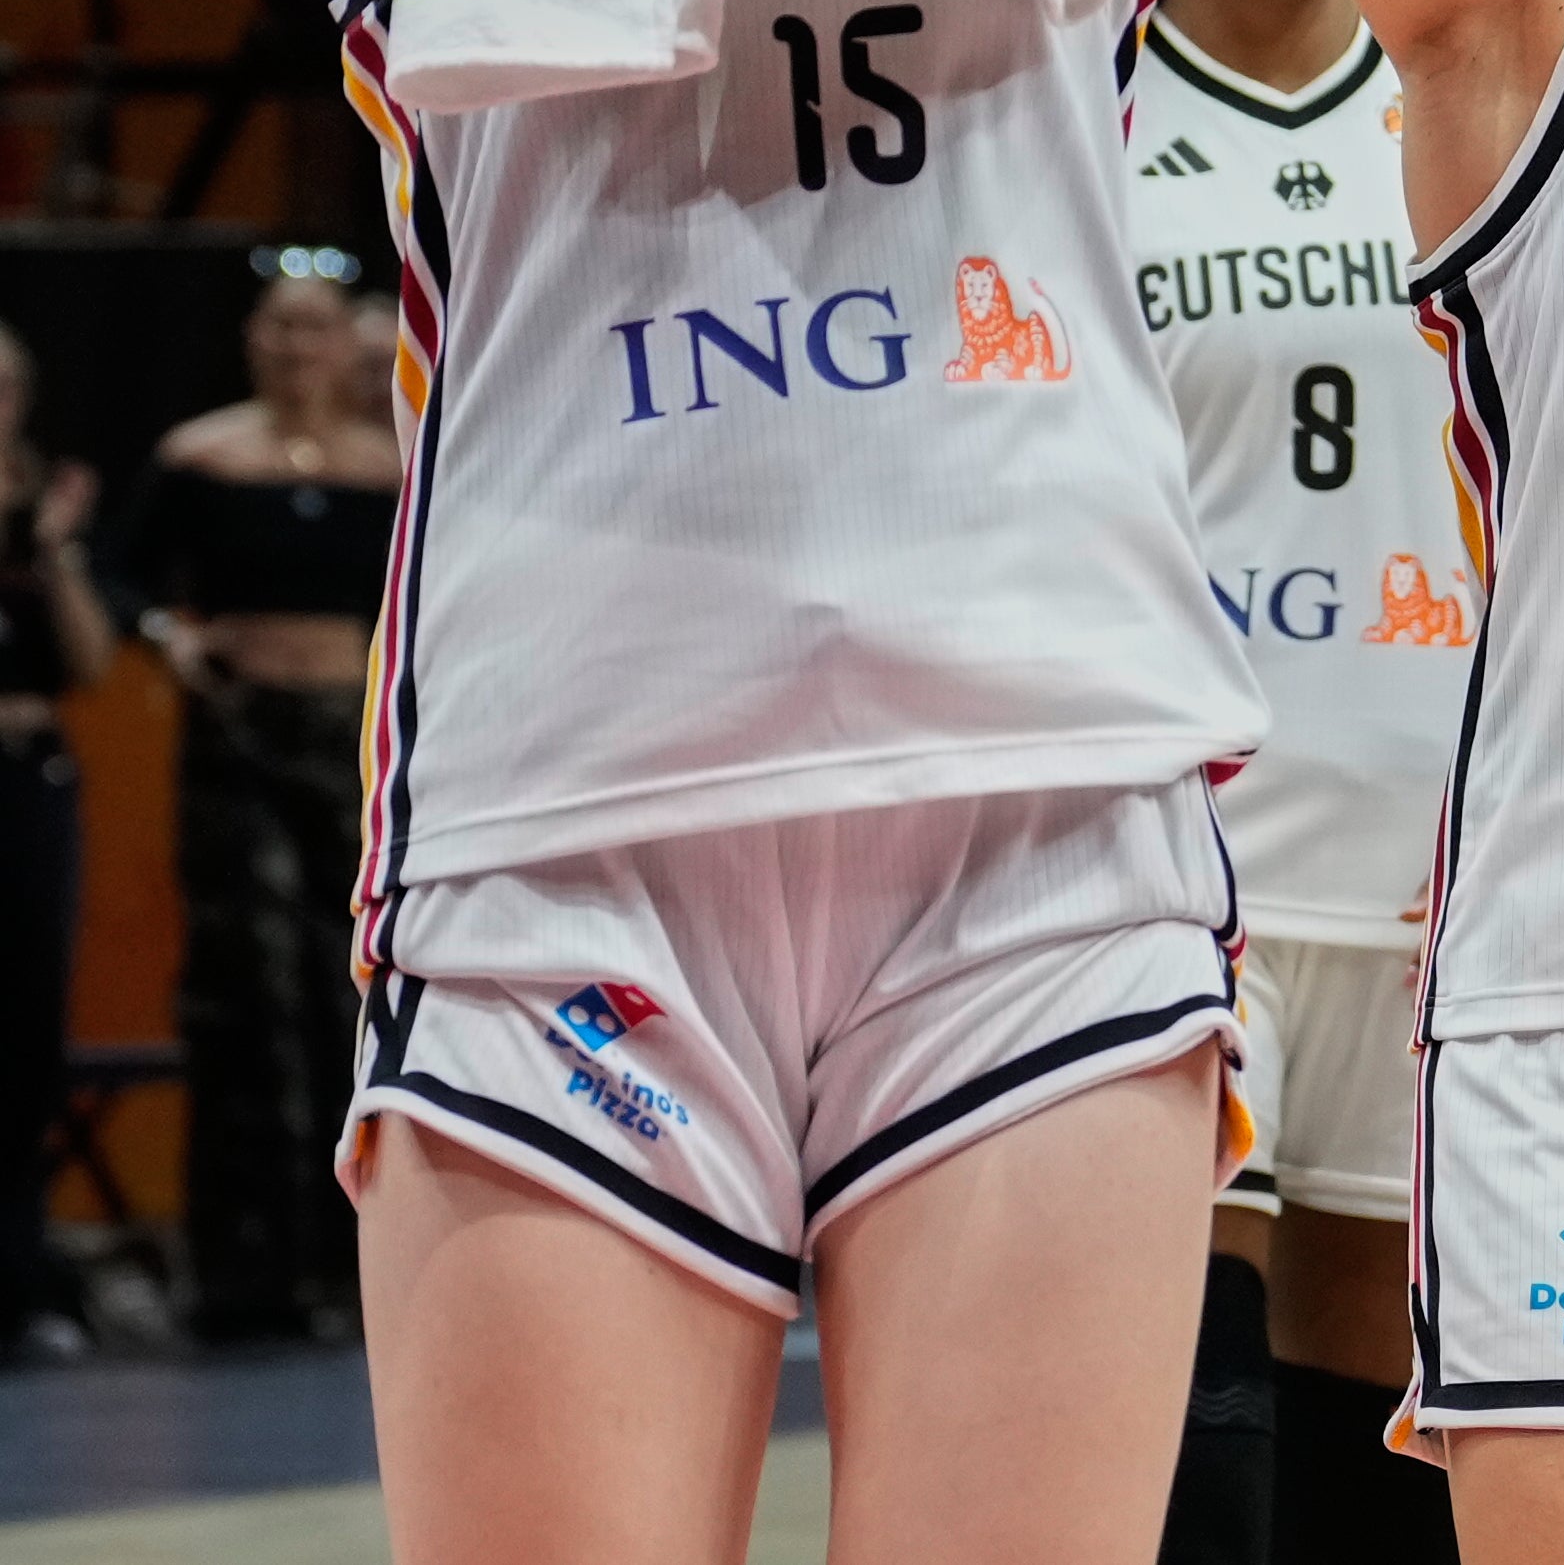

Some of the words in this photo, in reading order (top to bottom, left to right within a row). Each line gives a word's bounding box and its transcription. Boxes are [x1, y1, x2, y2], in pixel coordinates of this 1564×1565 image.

[773, 5, 926, 191] 15
[1137, 241, 1411, 333] EUTSCHL
[610, 288, 911, 426] ING
[1292, 364, 1355, 491] 8
[1208, 567, 1343, 641] NG
[567, 1066, 660, 1141] Pizza
